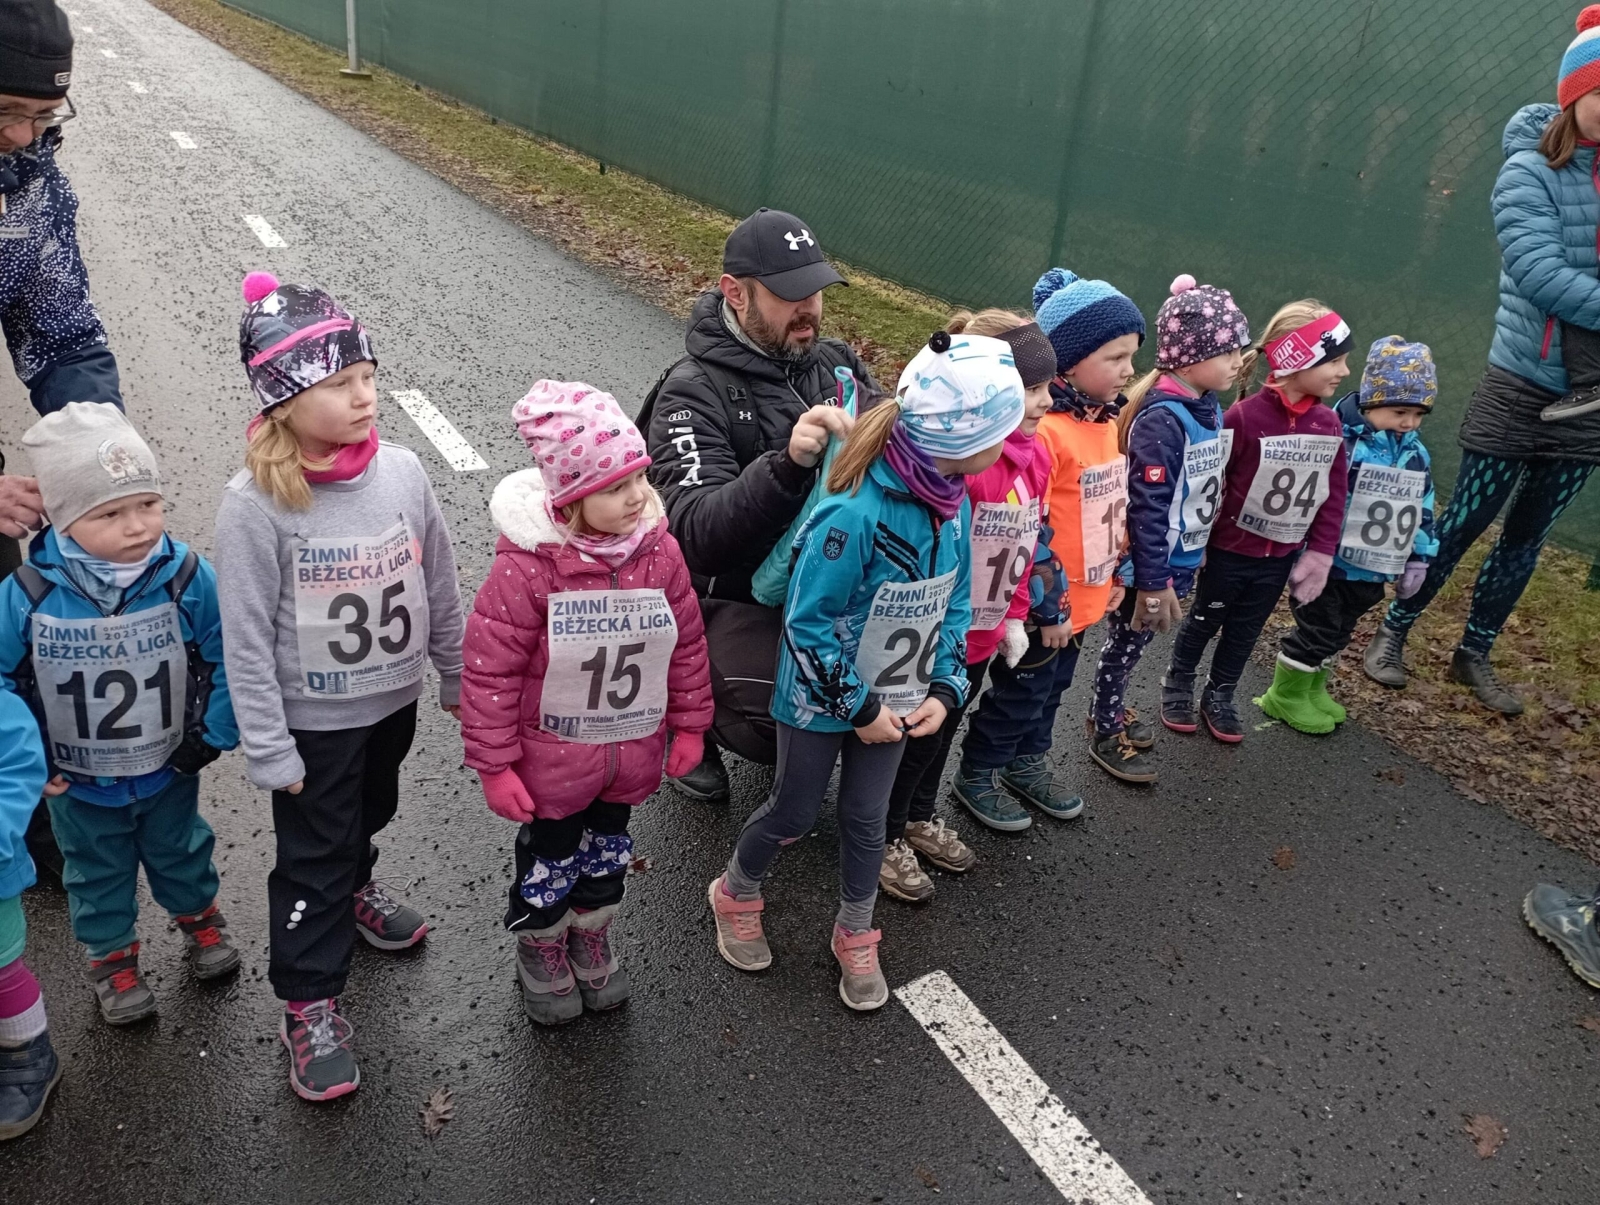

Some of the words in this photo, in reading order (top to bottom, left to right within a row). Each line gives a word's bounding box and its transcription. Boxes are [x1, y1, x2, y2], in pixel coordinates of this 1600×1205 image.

[1273, 339, 1295, 366] KUP
[1186, 443, 1219, 462] ZIMNÍ
[1265, 437, 1301, 450] ZIMNÍ
[668, 426, 703, 487] Audi
[1264, 447, 1313, 463] BĚŽECKÁ
[1085, 465, 1113, 484] ZIMNÍ
[1188, 458, 1220, 475] BĚŽEC
[1361, 469, 1401, 483] ZIMNÍ
[1262, 468, 1320, 517] 84
[1358, 481, 1412, 498] BĚŽECKÁ
[978, 509, 1022, 524] ZIMNÍ
[1361, 500, 1418, 551] 89
[973, 523, 1024, 540] BĚŽECK
[1022, 519, 1040, 534] LIG
[298, 544, 359, 563] ZIMNÍ
[298, 561, 384, 582] BĚŽECKÁ
[388, 548, 412, 573] LIGA
[986, 545, 1031, 603] 19
[878, 585, 927, 603] ZIMNÍ
[553, 596, 608, 616] ZIMNÍ
[873, 597, 938, 619] BĚŽECKÁ
[110, 623, 130, 632] KRÁLE
[327, 580, 412, 665] 35
[552, 615, 631, 636] BĚŽECKÁ
[640, 613, 673, 630] LIGA
[38, 623, 97, 643] ZIMNÍ
[38, 641, 128, 660] BĚŽECKÁ
[137, 631, 177, 654] LIGA
[874, 620, 941, 687] 26
[350, 664, 384, 677] VYRÁBÍME
[580, 642, 646, 710] 15
[56, 659, 172, 740] 121
[583, 715, 614, 724] VYRÁBÍME
[616, 709, 646, 722] STARTOVNÍ
[647, 707, 662, 716] ČÍSLA
[92, 746, 130, 755] VYRÁBÍME
